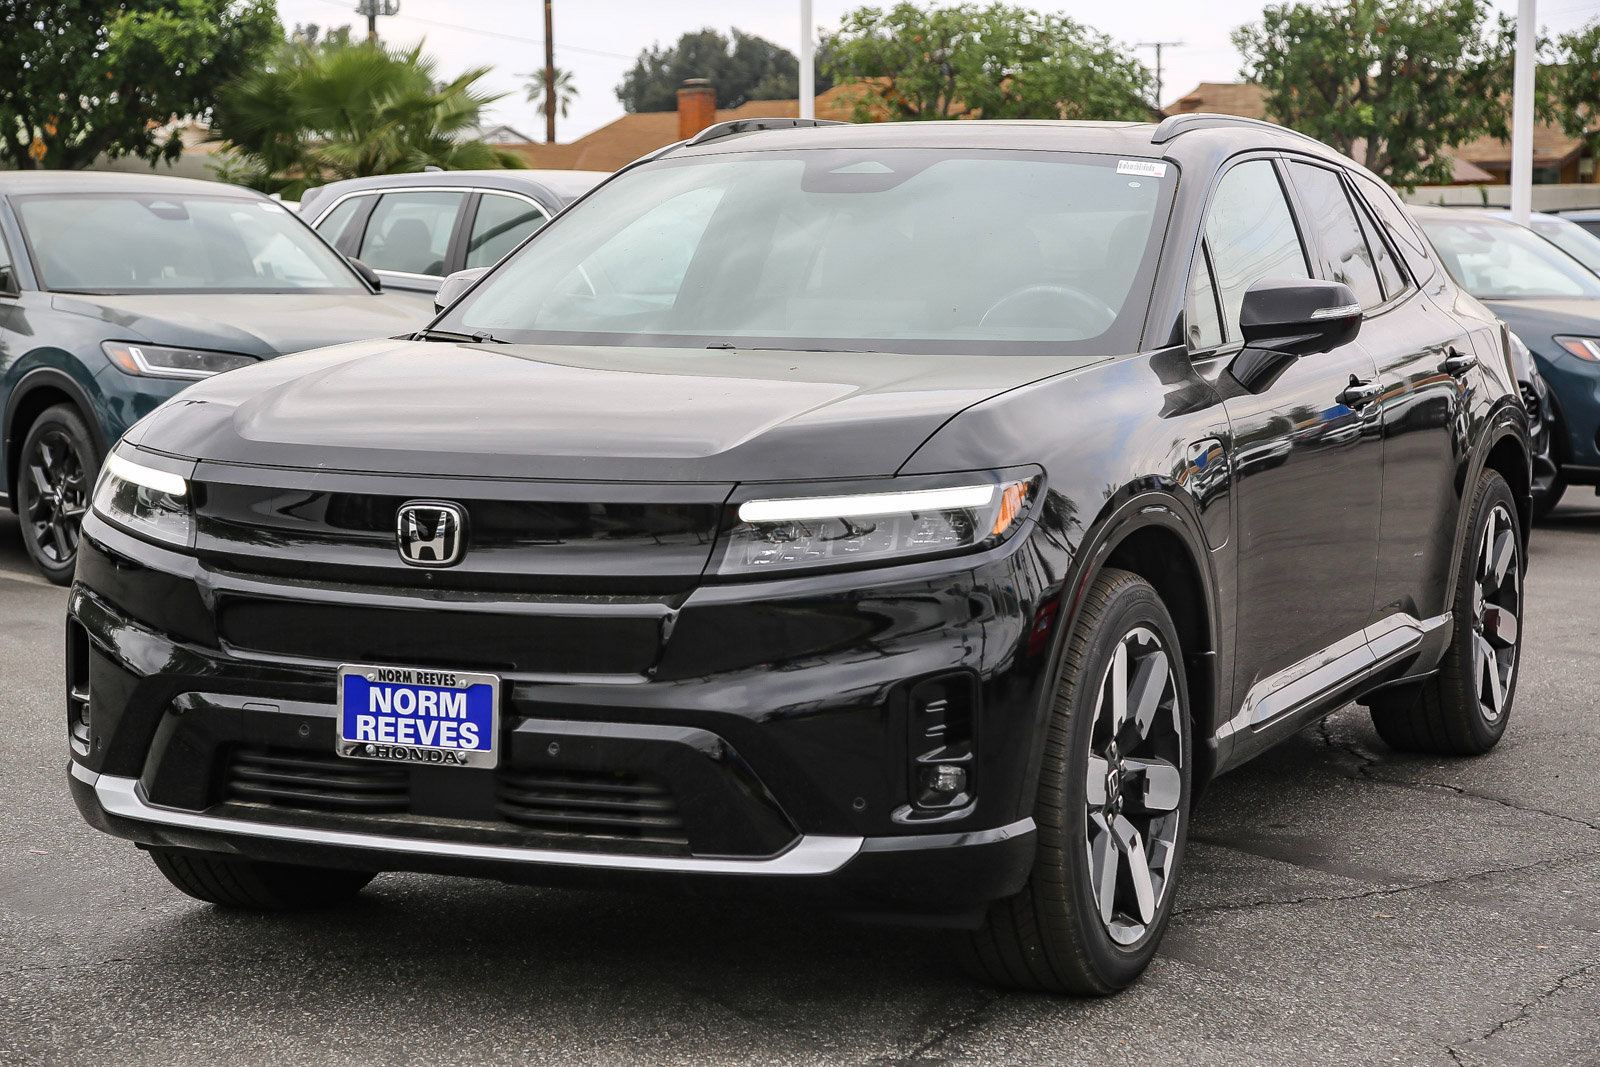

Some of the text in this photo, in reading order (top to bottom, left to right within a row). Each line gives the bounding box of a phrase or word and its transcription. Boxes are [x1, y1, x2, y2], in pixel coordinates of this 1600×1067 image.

[378, 669, 456, 687] NORM REEVES
[369, 686, 467, 719] NORM
[356, 714, 480, 749] REEVES
[375, 744, 463, 764] HONDA
